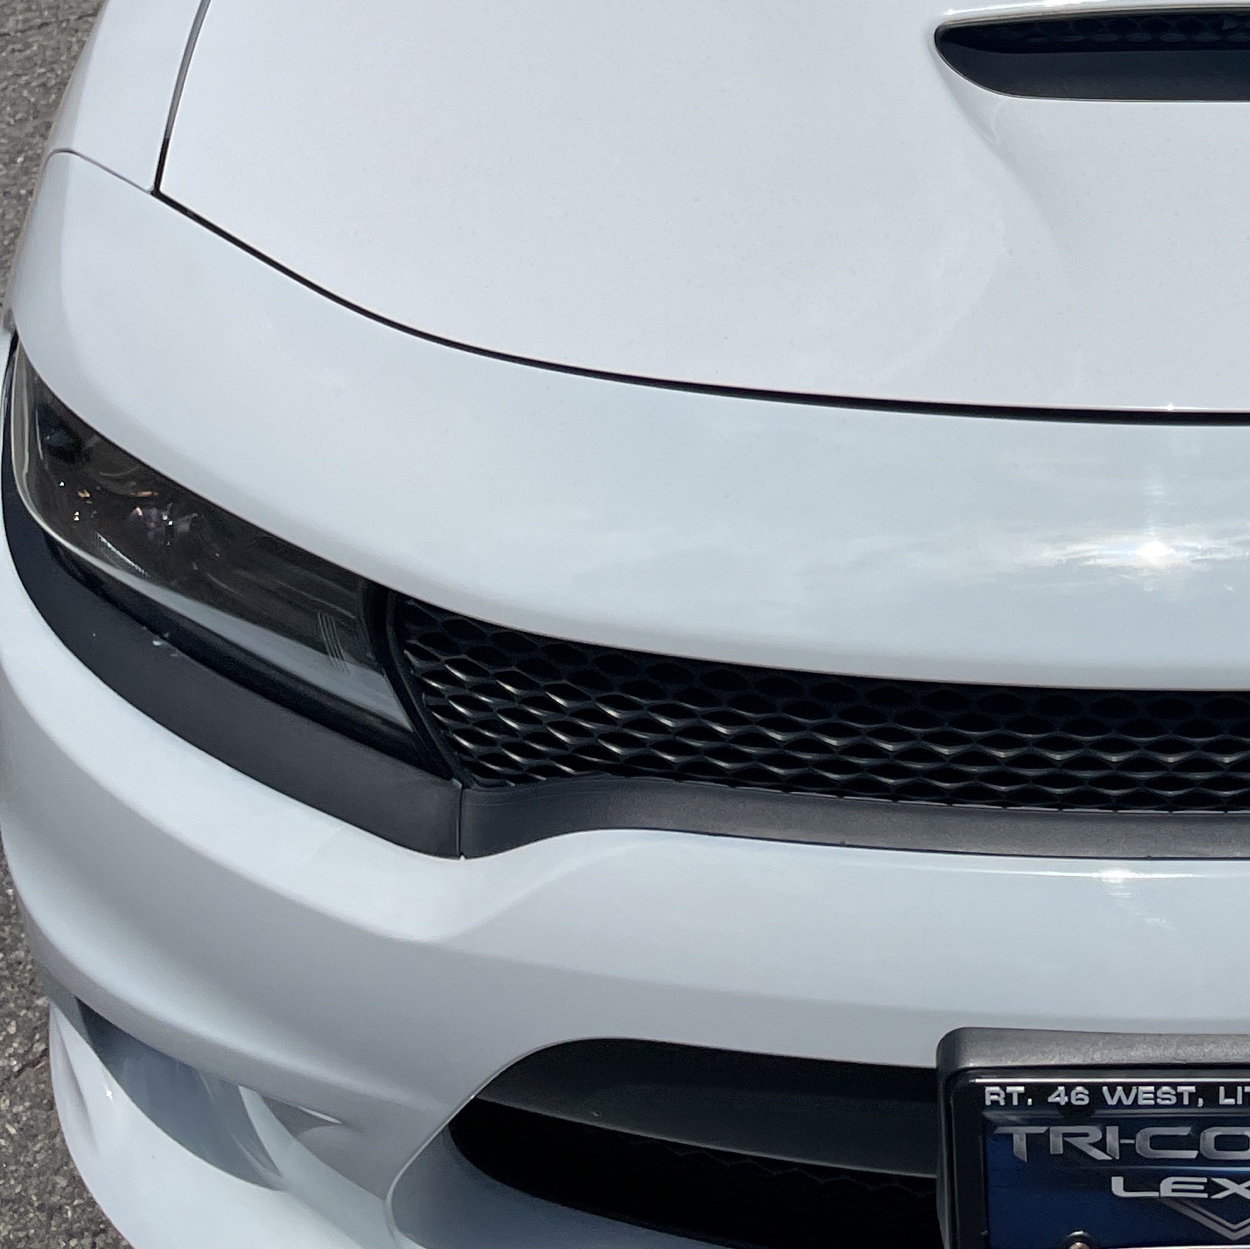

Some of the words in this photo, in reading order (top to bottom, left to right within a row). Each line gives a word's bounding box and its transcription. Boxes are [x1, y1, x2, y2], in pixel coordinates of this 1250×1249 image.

[984, 1085, 1033, 1106] RT.
[1047, 1085, 1090, 1106] 46
[1101, 1085, 1204, 1108] WEST,
